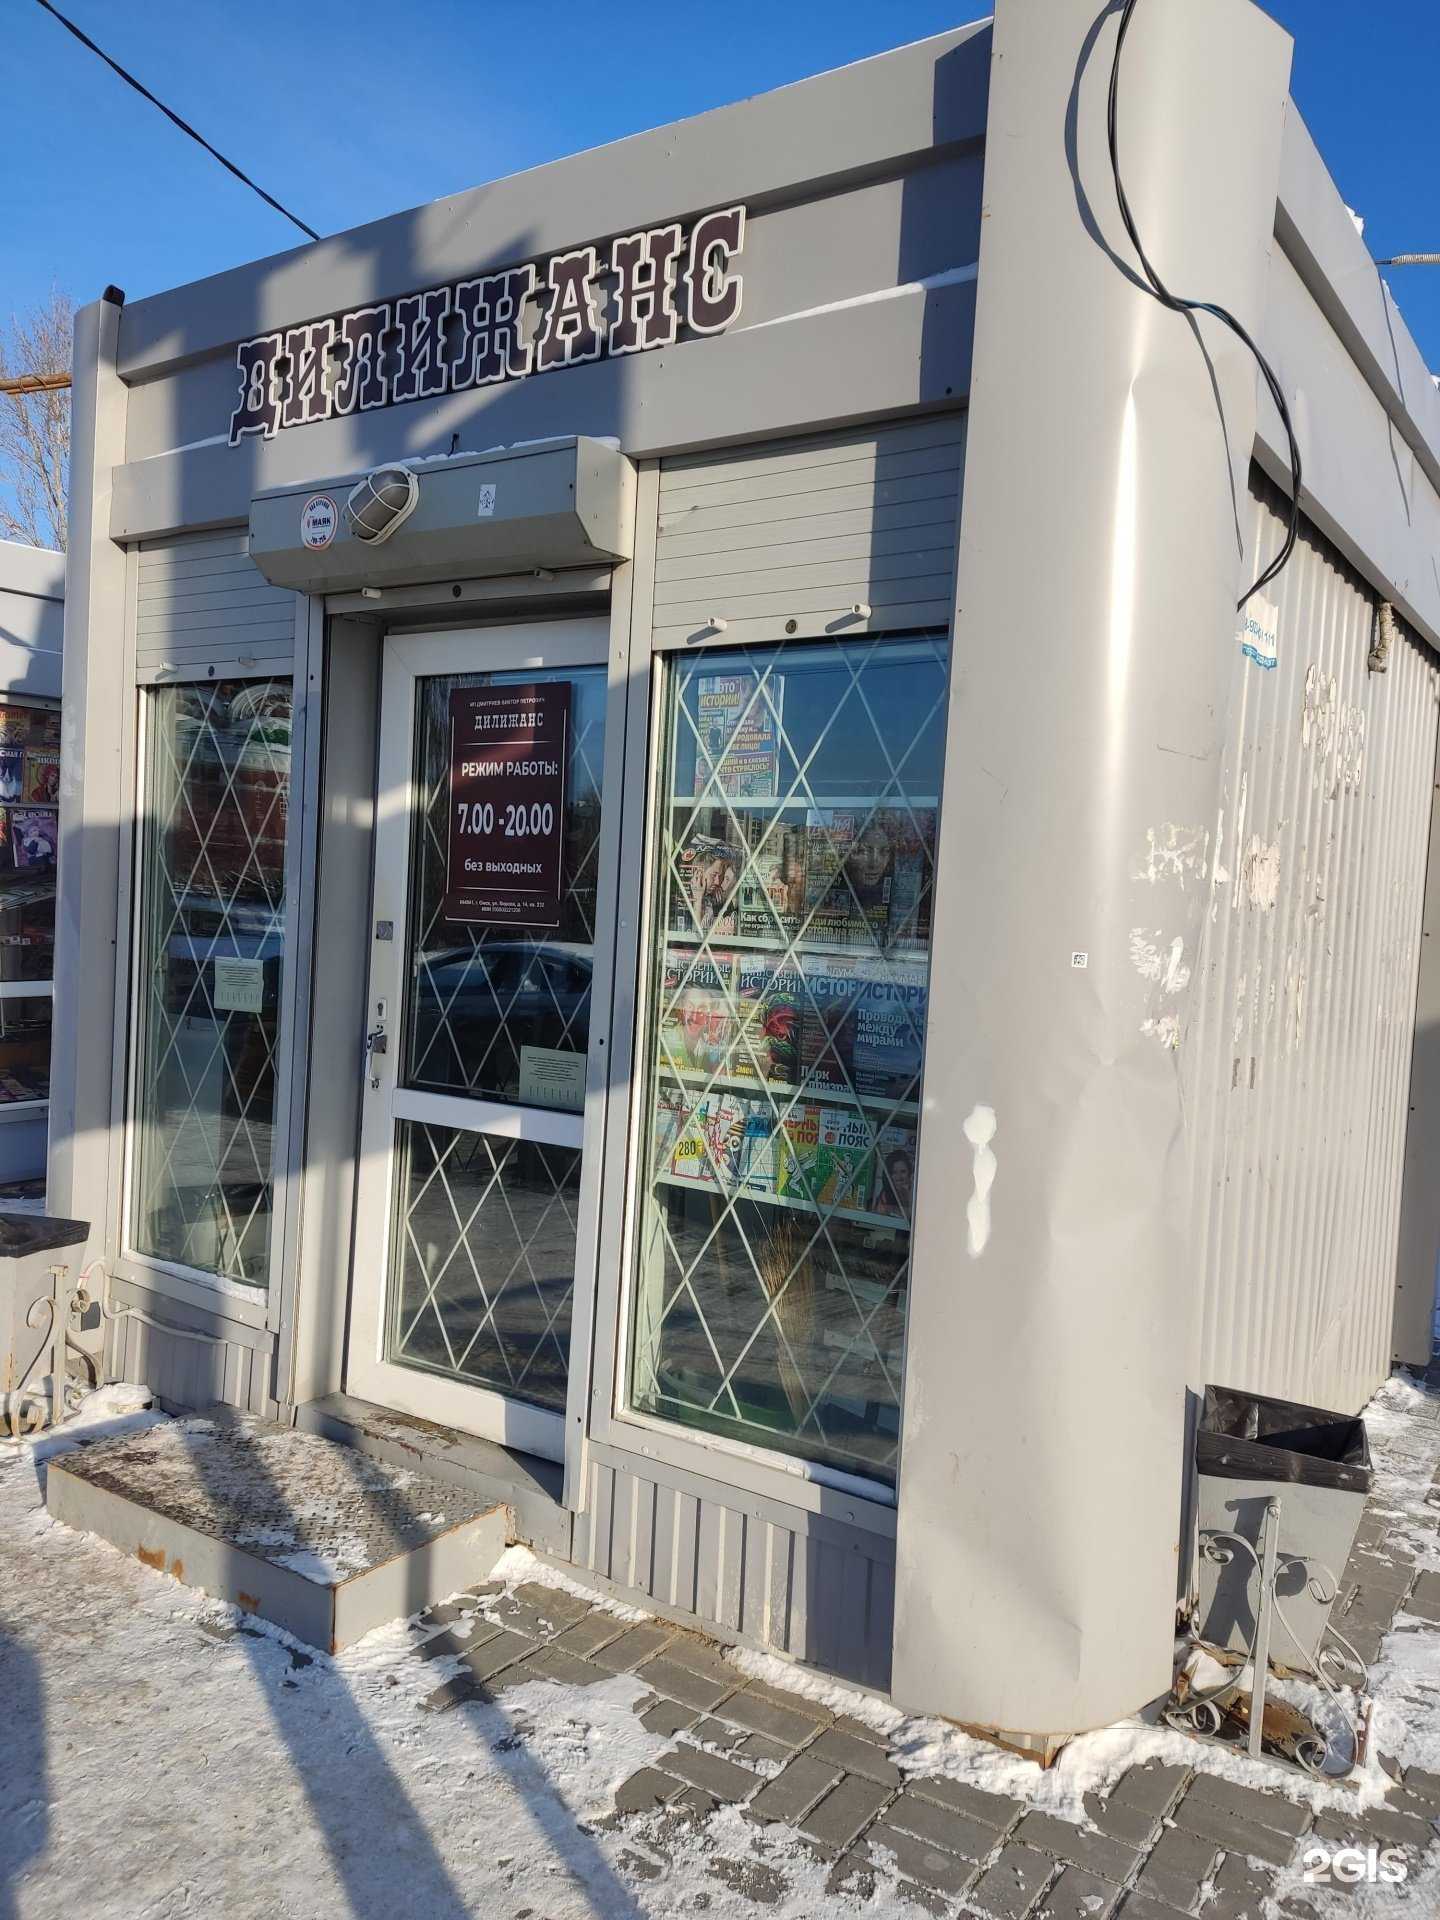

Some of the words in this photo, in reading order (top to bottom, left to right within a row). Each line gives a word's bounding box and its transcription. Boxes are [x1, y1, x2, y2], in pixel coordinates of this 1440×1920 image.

[228, 204, 747, 447] ДИЛИЖАНС
[311, 516, 331, 527] МАЯК
[474, 713, 544, 731] ДИЛИЖАНС
[461, 761, 504, 777] РЕЖИМ
[506, 760, 558, 776] РАБОТЫ:
[457, 802, 494, 835] 7.00
[464, 858, 483, 872] без
[485, 861, 543, 875] выходных
[740, 911, 757, 922] Как
[678, 1140, 697, 1156] 280
[838, 1133, 870, 1148] ПОЯС
